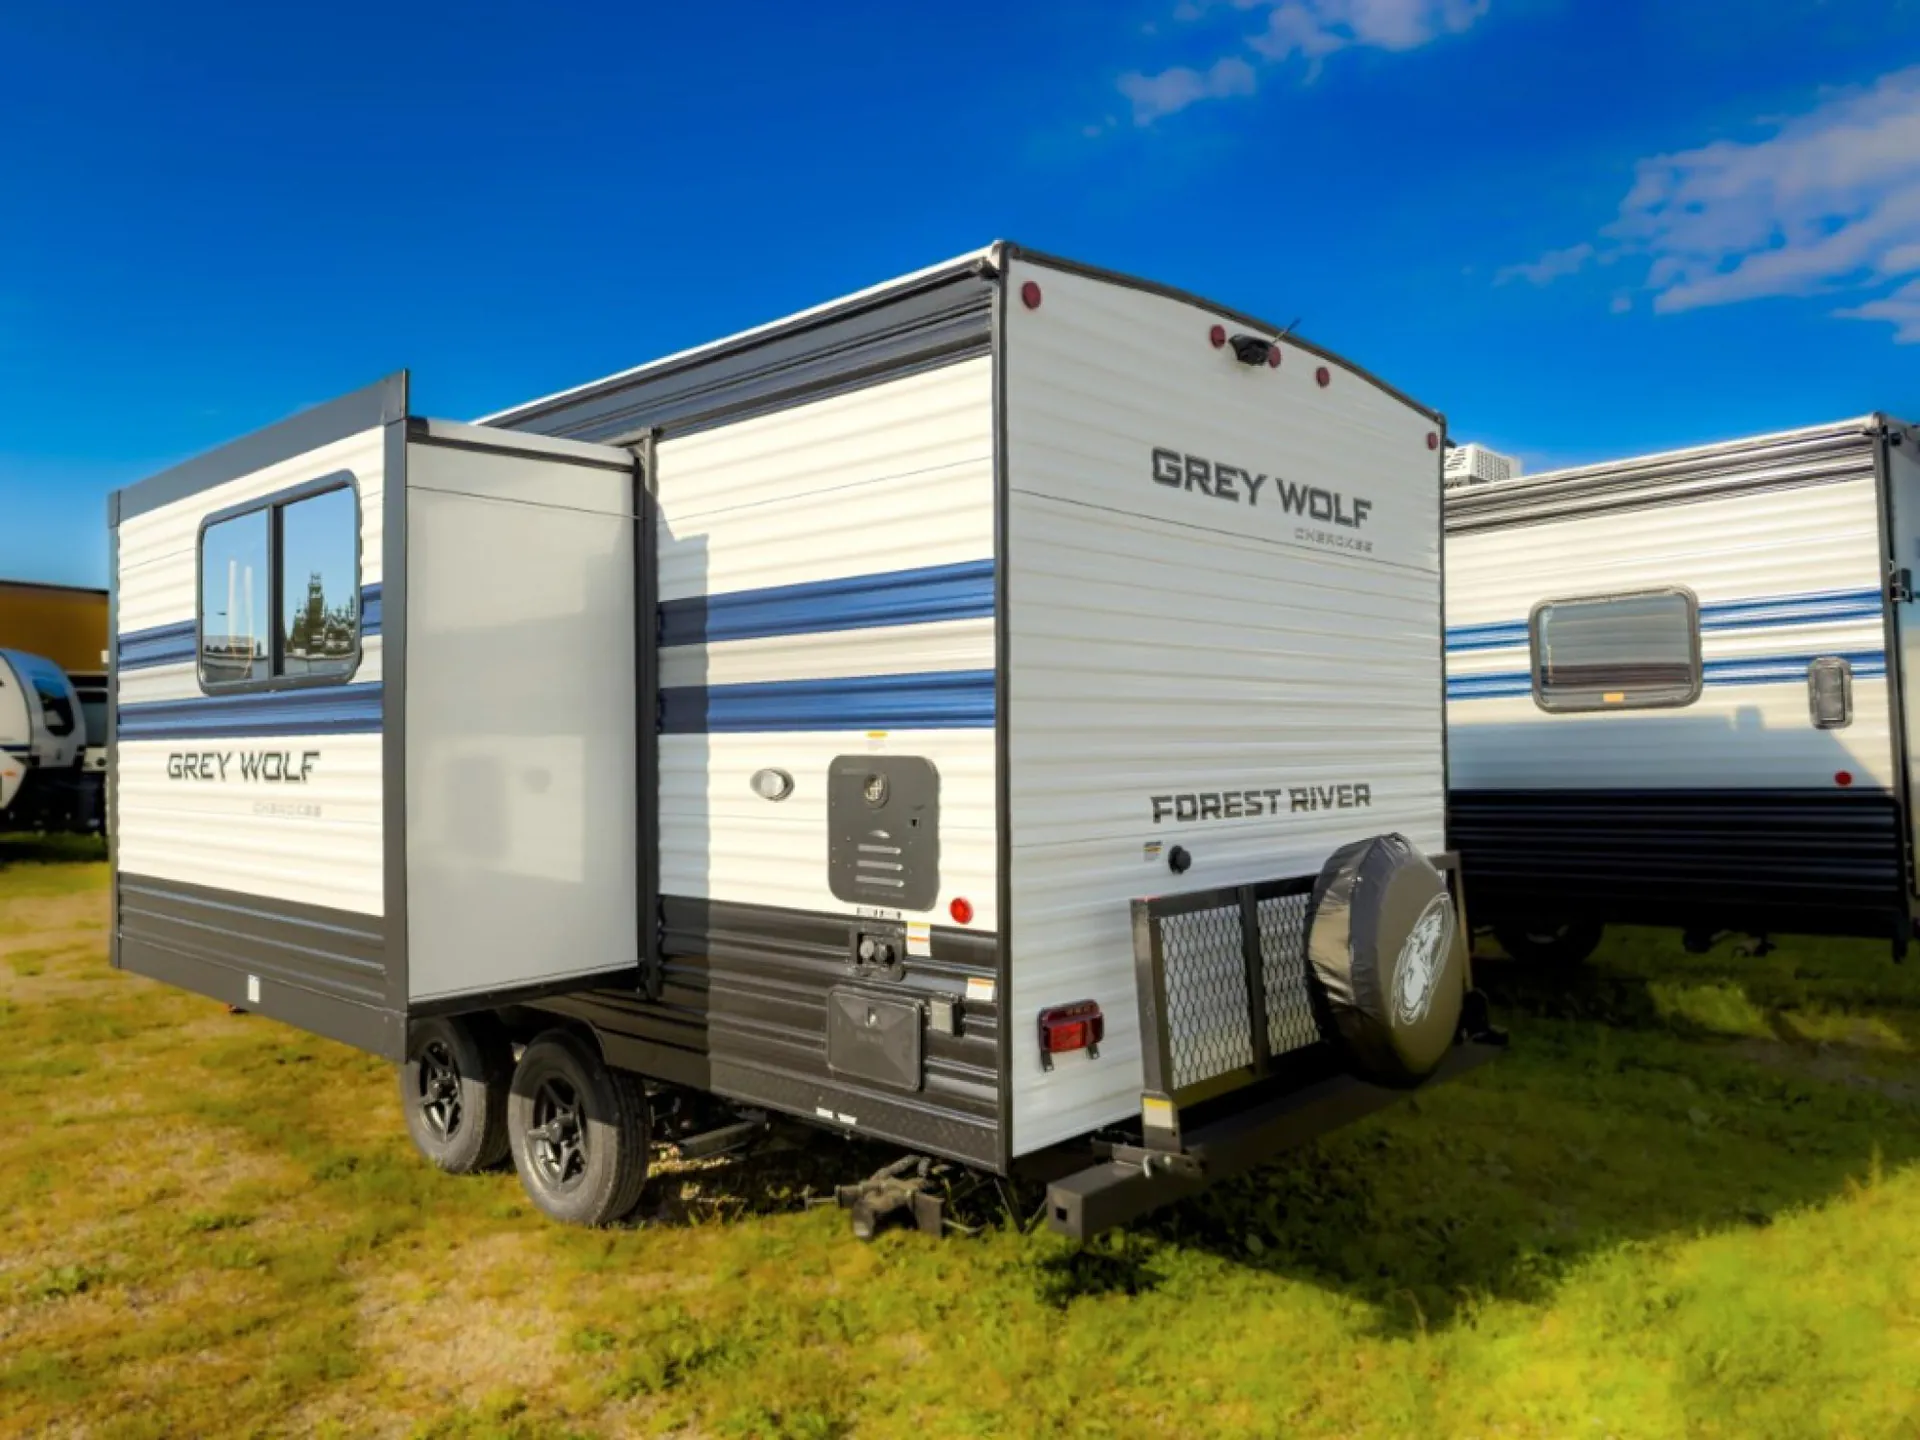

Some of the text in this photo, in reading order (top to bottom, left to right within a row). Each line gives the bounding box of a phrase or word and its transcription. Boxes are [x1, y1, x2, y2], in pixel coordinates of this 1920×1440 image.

[1152, 446, 1373, 530] GREY WOLF
[1293, 526, 1374, 554] CHEROKEE
[167, 750, 321, 784] GREY WOLF
[1150, 782, 1372, 824] FOREST RIVER
